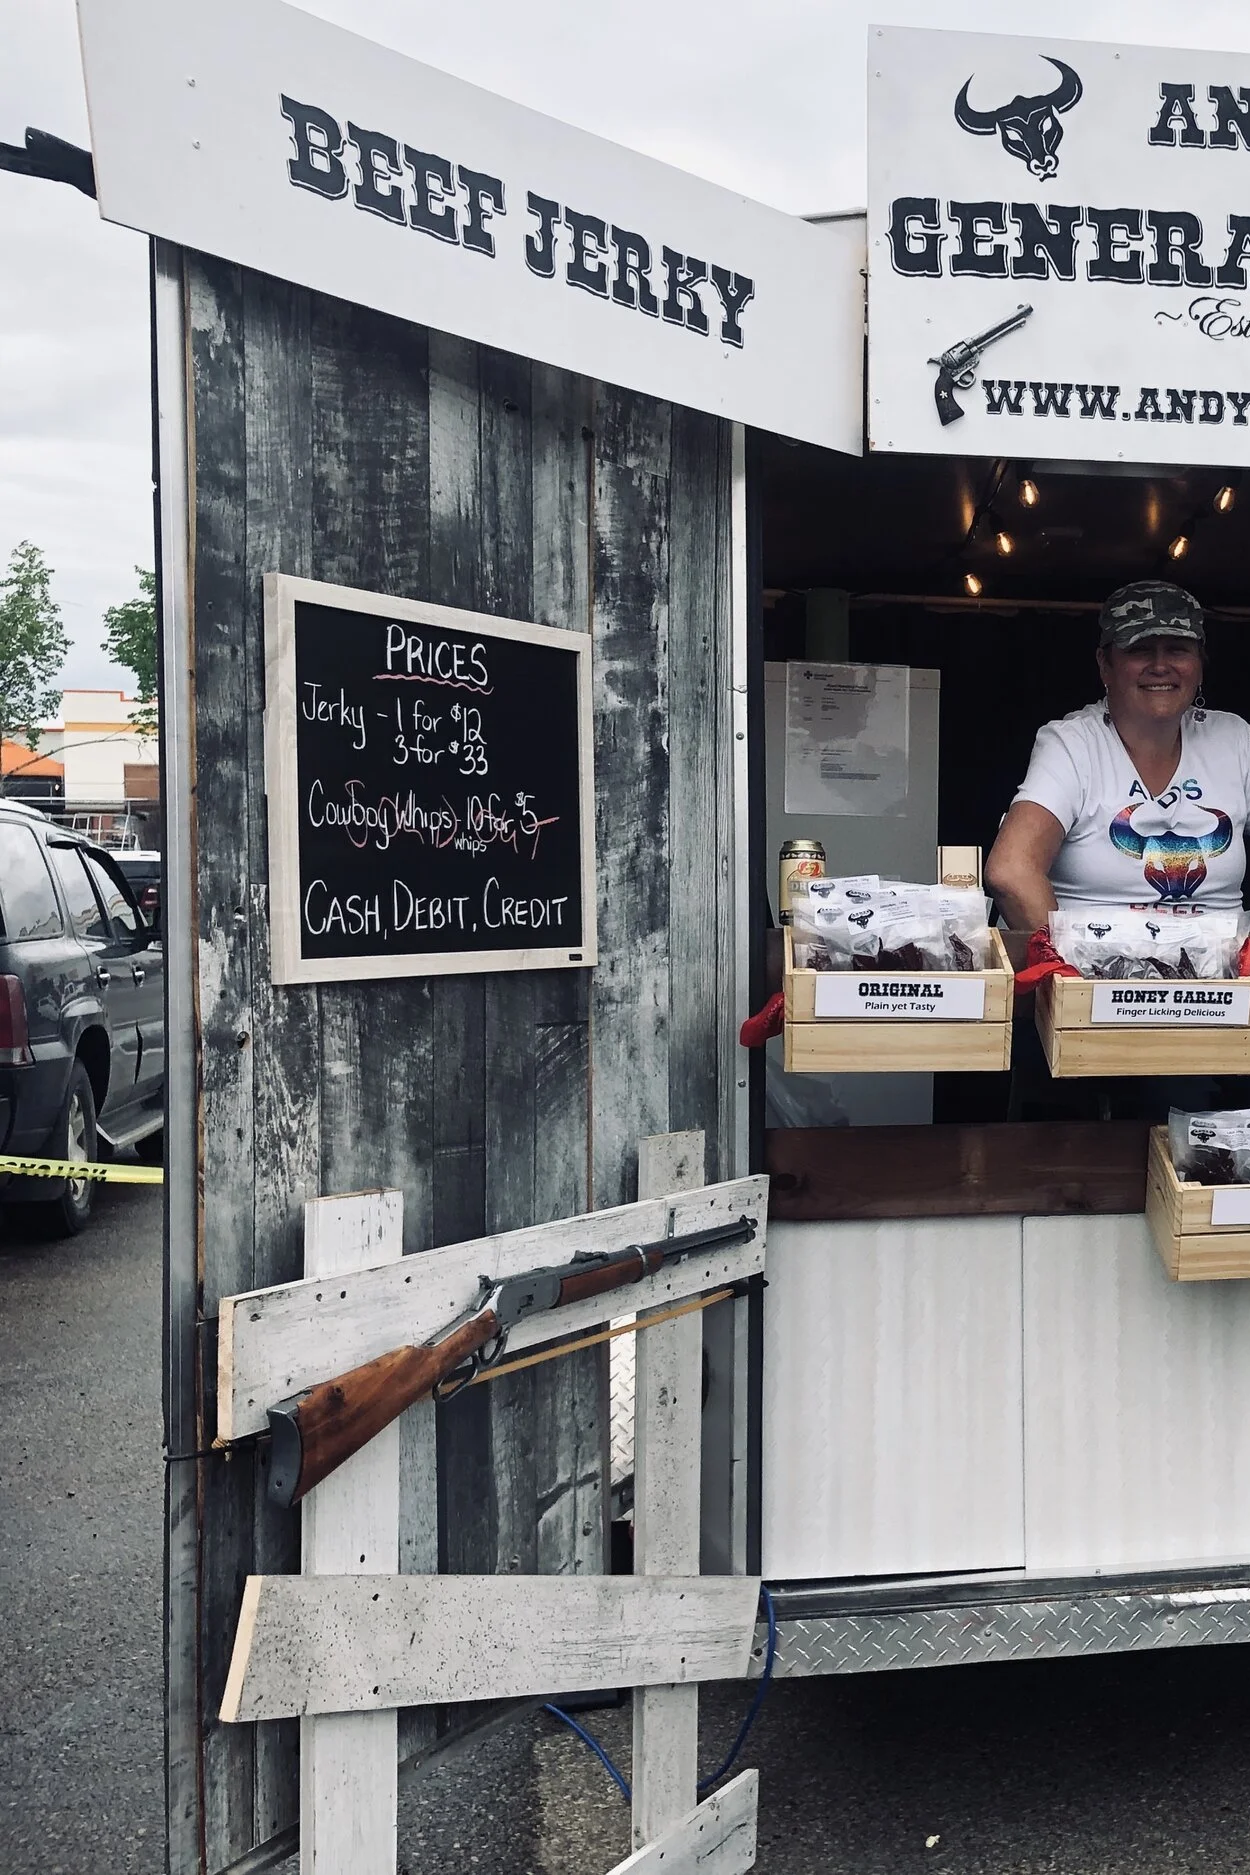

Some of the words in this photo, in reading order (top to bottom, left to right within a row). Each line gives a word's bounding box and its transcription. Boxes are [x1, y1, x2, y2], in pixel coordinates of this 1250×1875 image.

[279, 92, 506, 258] BEEF
[523, 190, 756, 350] JERKY
[385, 623, 489, 686] PRICES
[302, 681, 366, 750] Jerky
[412, 699, 442, 733] for
[450, 702, 488, 745] $12
[393, 734, 409, 765] 3
[409, 735, 445, 765] for
[449, 740, 489, 776] $33
[308, 778, 391, 850] Cowboy
[453, 834, 488, 859] whips
[304, 879, 389, 941] CASH,
[483, 876, 569, 928] CREDIT
[858, 982, 944, 998] ORIGINAL
[865, 1001, 889, 1011] Plain
[891, 1002, 907, 1013] yet
[909, 1002, 936, 1013] Tasty
[1111, 990, 1169, 1004] HONEY
[1173, 990, 1233, 1005] GARLIC
[1116, 1007, 1147, 1018] Finger
[1148, 1007, 1182, 1018] Licking
[1183, 1008, 1226, 1017] Delicious
